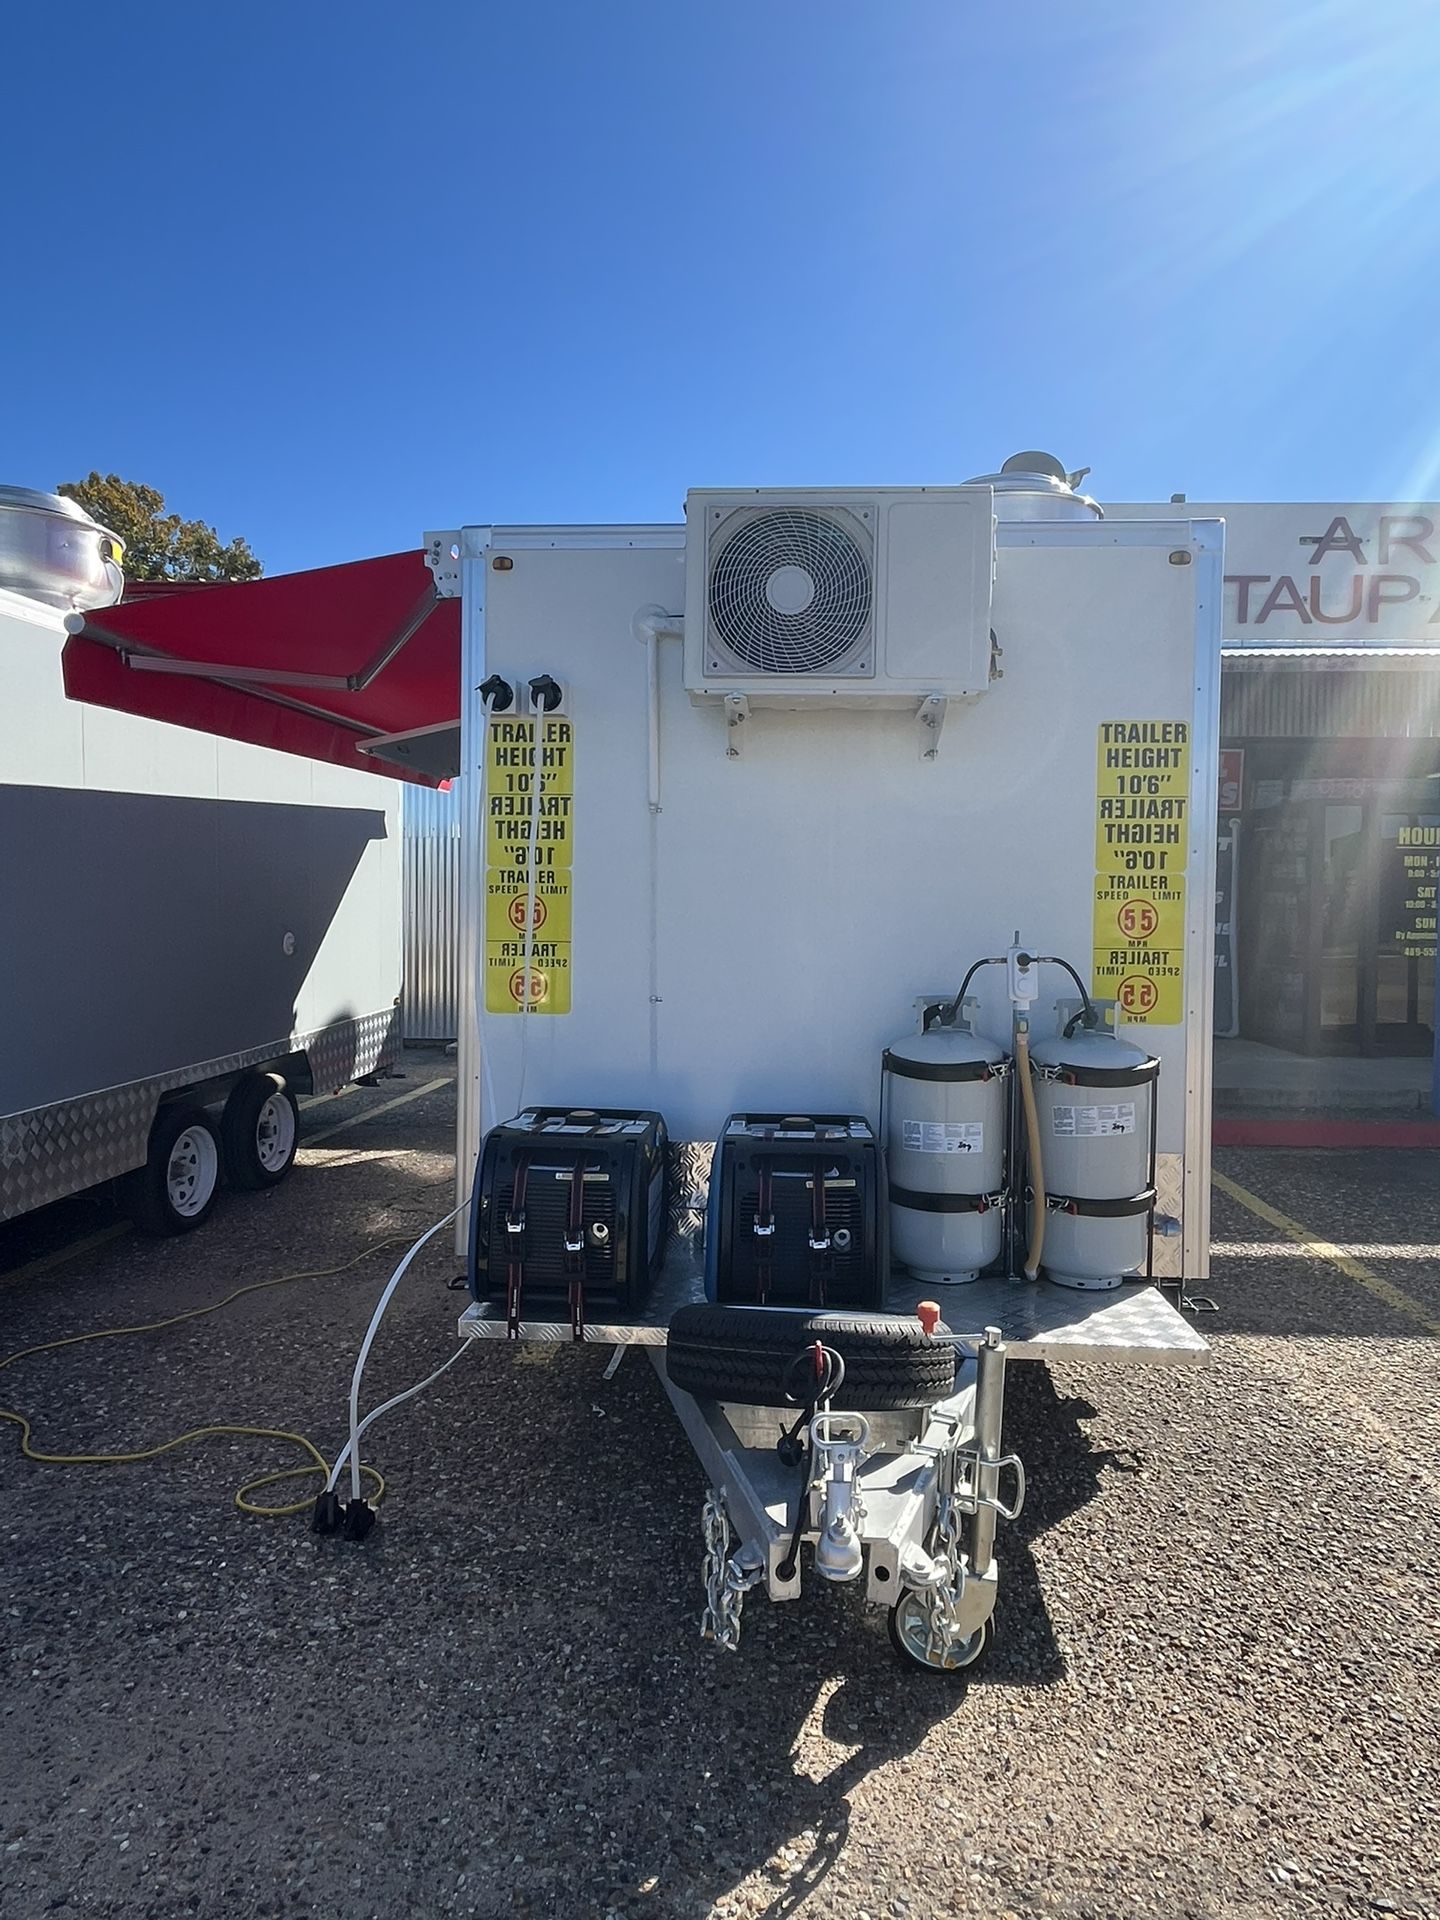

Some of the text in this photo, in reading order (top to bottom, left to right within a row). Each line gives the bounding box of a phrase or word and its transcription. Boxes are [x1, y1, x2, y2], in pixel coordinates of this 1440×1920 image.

[490, 723, 570, 742] TRAIER
[1101, 723, 1187, 743] TRAILER
[1106, 748, 1182, 768] HEIGHT
[1117, 775, 1171, 794] 10'6"
[1404, 856, 1427, 866] MON
[499, 870, 555, 884] TRAIER
[1108, 875, 1168, 890] TRAILER
[489, 885, 568, 894] SPEED LIMIT
[1097, 891, 1181, 901] SPEED LIMIT
[1417, 886, 1437, 898] SAT
[514, 903, 541, 924] 55
[1124, 909, 1153, 932] 55
[1415, 917, 1436, 929] SUN
